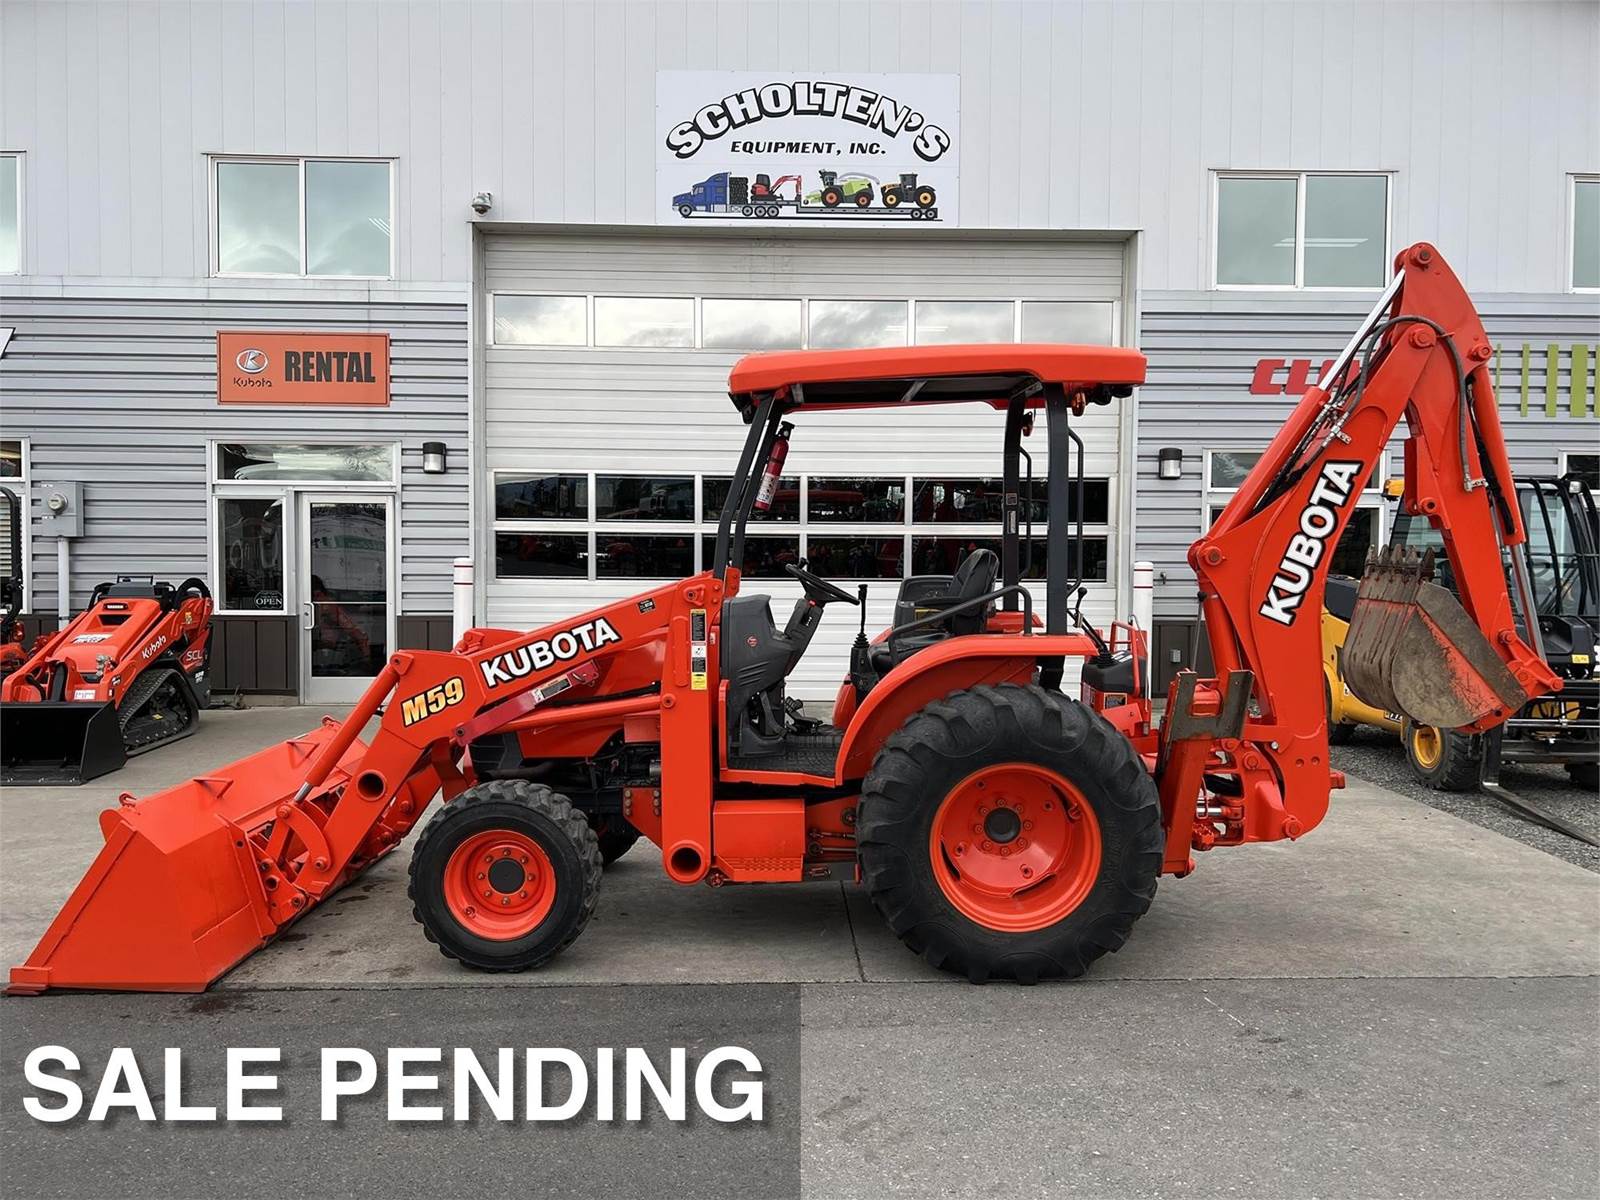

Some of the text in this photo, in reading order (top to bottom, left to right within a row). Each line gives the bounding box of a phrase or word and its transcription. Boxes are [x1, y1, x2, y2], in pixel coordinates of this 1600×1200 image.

[666, 82, 951, 162] SCHOLTEN'S
[730, 141, 887, 155] EQUIPMENT, INC.
[233, 376, 272, 388] Kubota
[284, 350, 376, 383] RENTAL
[1259, 460, 1363, 626] KUBOTA
[141, 634, 167, 660] Kubota
[480, 617, 621, 688] KUBOTA
[401, 677, 465, 727] M59
